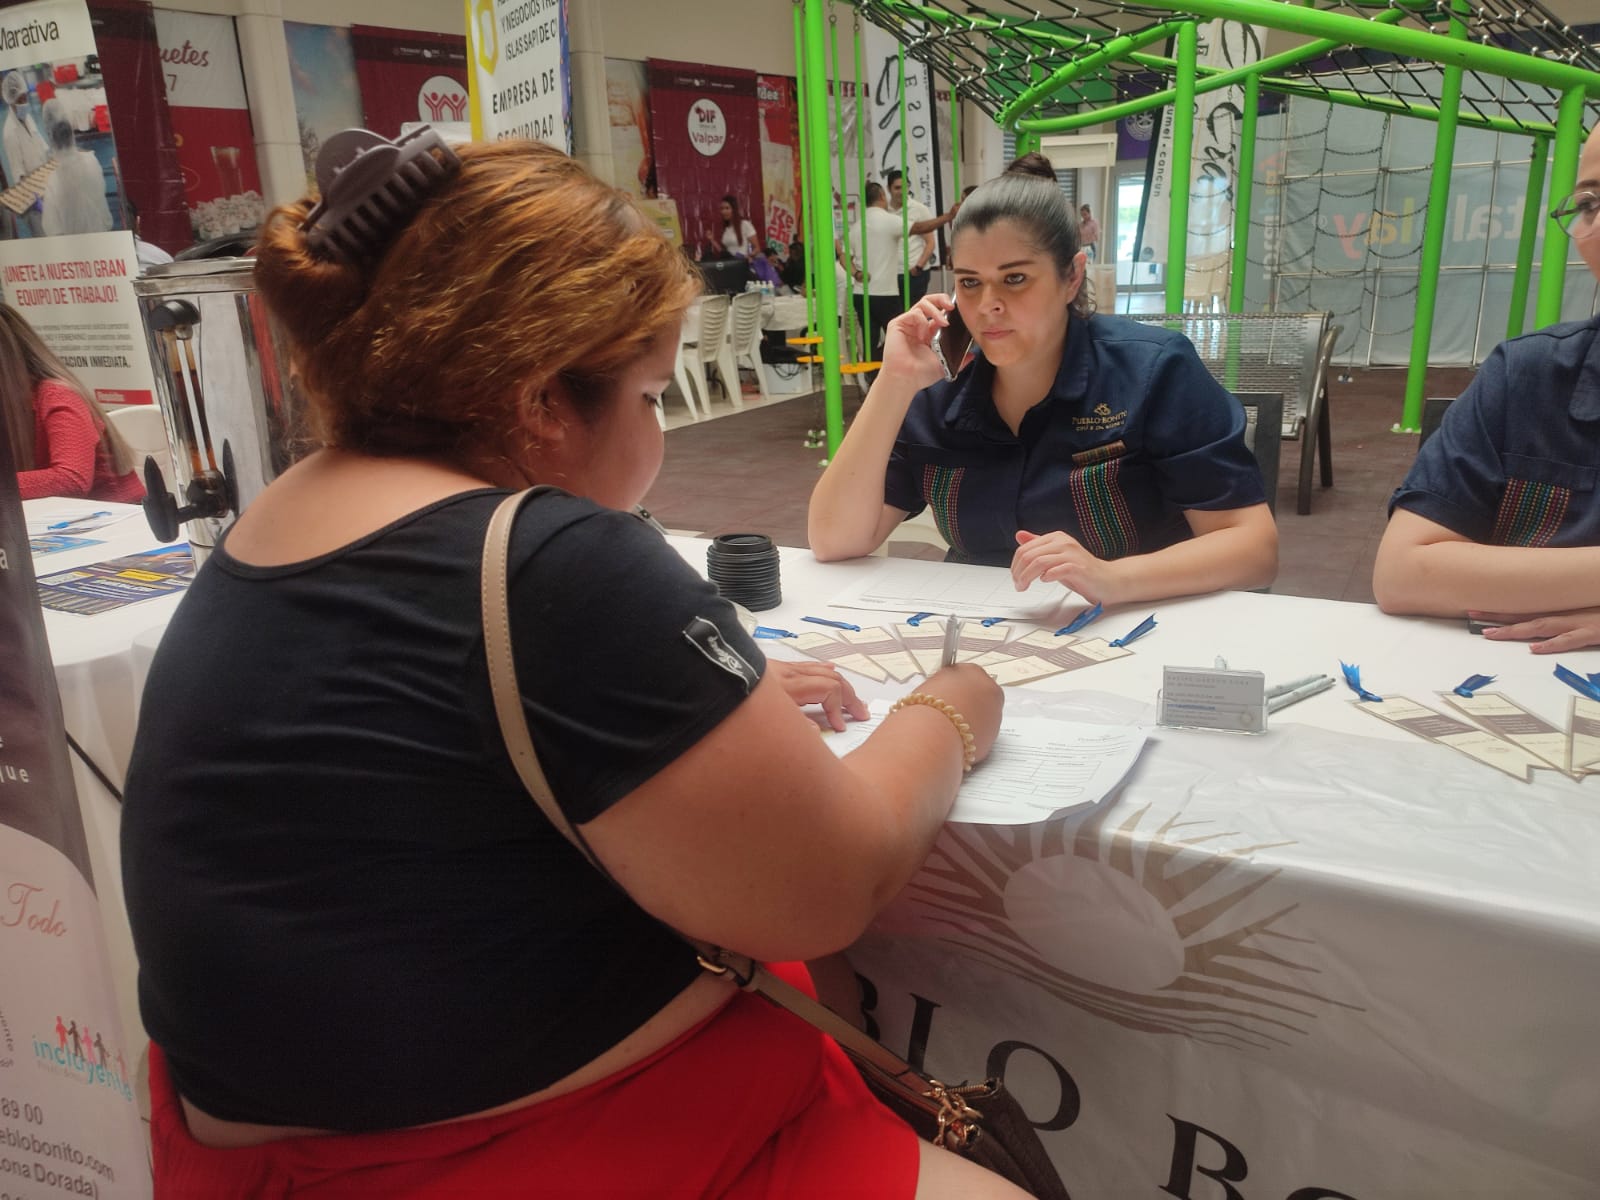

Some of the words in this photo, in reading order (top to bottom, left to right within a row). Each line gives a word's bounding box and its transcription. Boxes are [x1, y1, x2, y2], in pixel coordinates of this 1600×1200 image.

[500, 15, 506, 33] Y
[506, 0, 541, 31] NEGOCIOS
[158, 39, 210, 68] uetes
[505, 36, 524, 61] ISLAS
[524, 28, 539, 51] SAPI
[539, 22, 550, 43] DE
[550, 17, 558, 38] C
[492, 76, 539, 115] EMPRESA
[542, 68, 554, 95] DE
[695, 107, 717, 124] DIF
[1162, 101, 1175, 140] zumel
[1153, 151, 1167, 198] cancun
[39, 263, 46, 281] A
[46, 261, 93, 281] NUESTRO
[93, 258, 127, 278] GRAN
[16, 288, 52, 307] EQUIPO
[53, 287, 69, 305] DE
[68, 284, 120, 305] TRABAJO!
[90, 355, 132, 369] INMEDIATA.
[0, 882, 68, 937] Todo
[1, 1096, 20, 1120] 89
[24, 1103, 43, 1126] 00
[0, 1157, 31, 1179] ona
[33, 1161, 99, 1200] Dorada)
